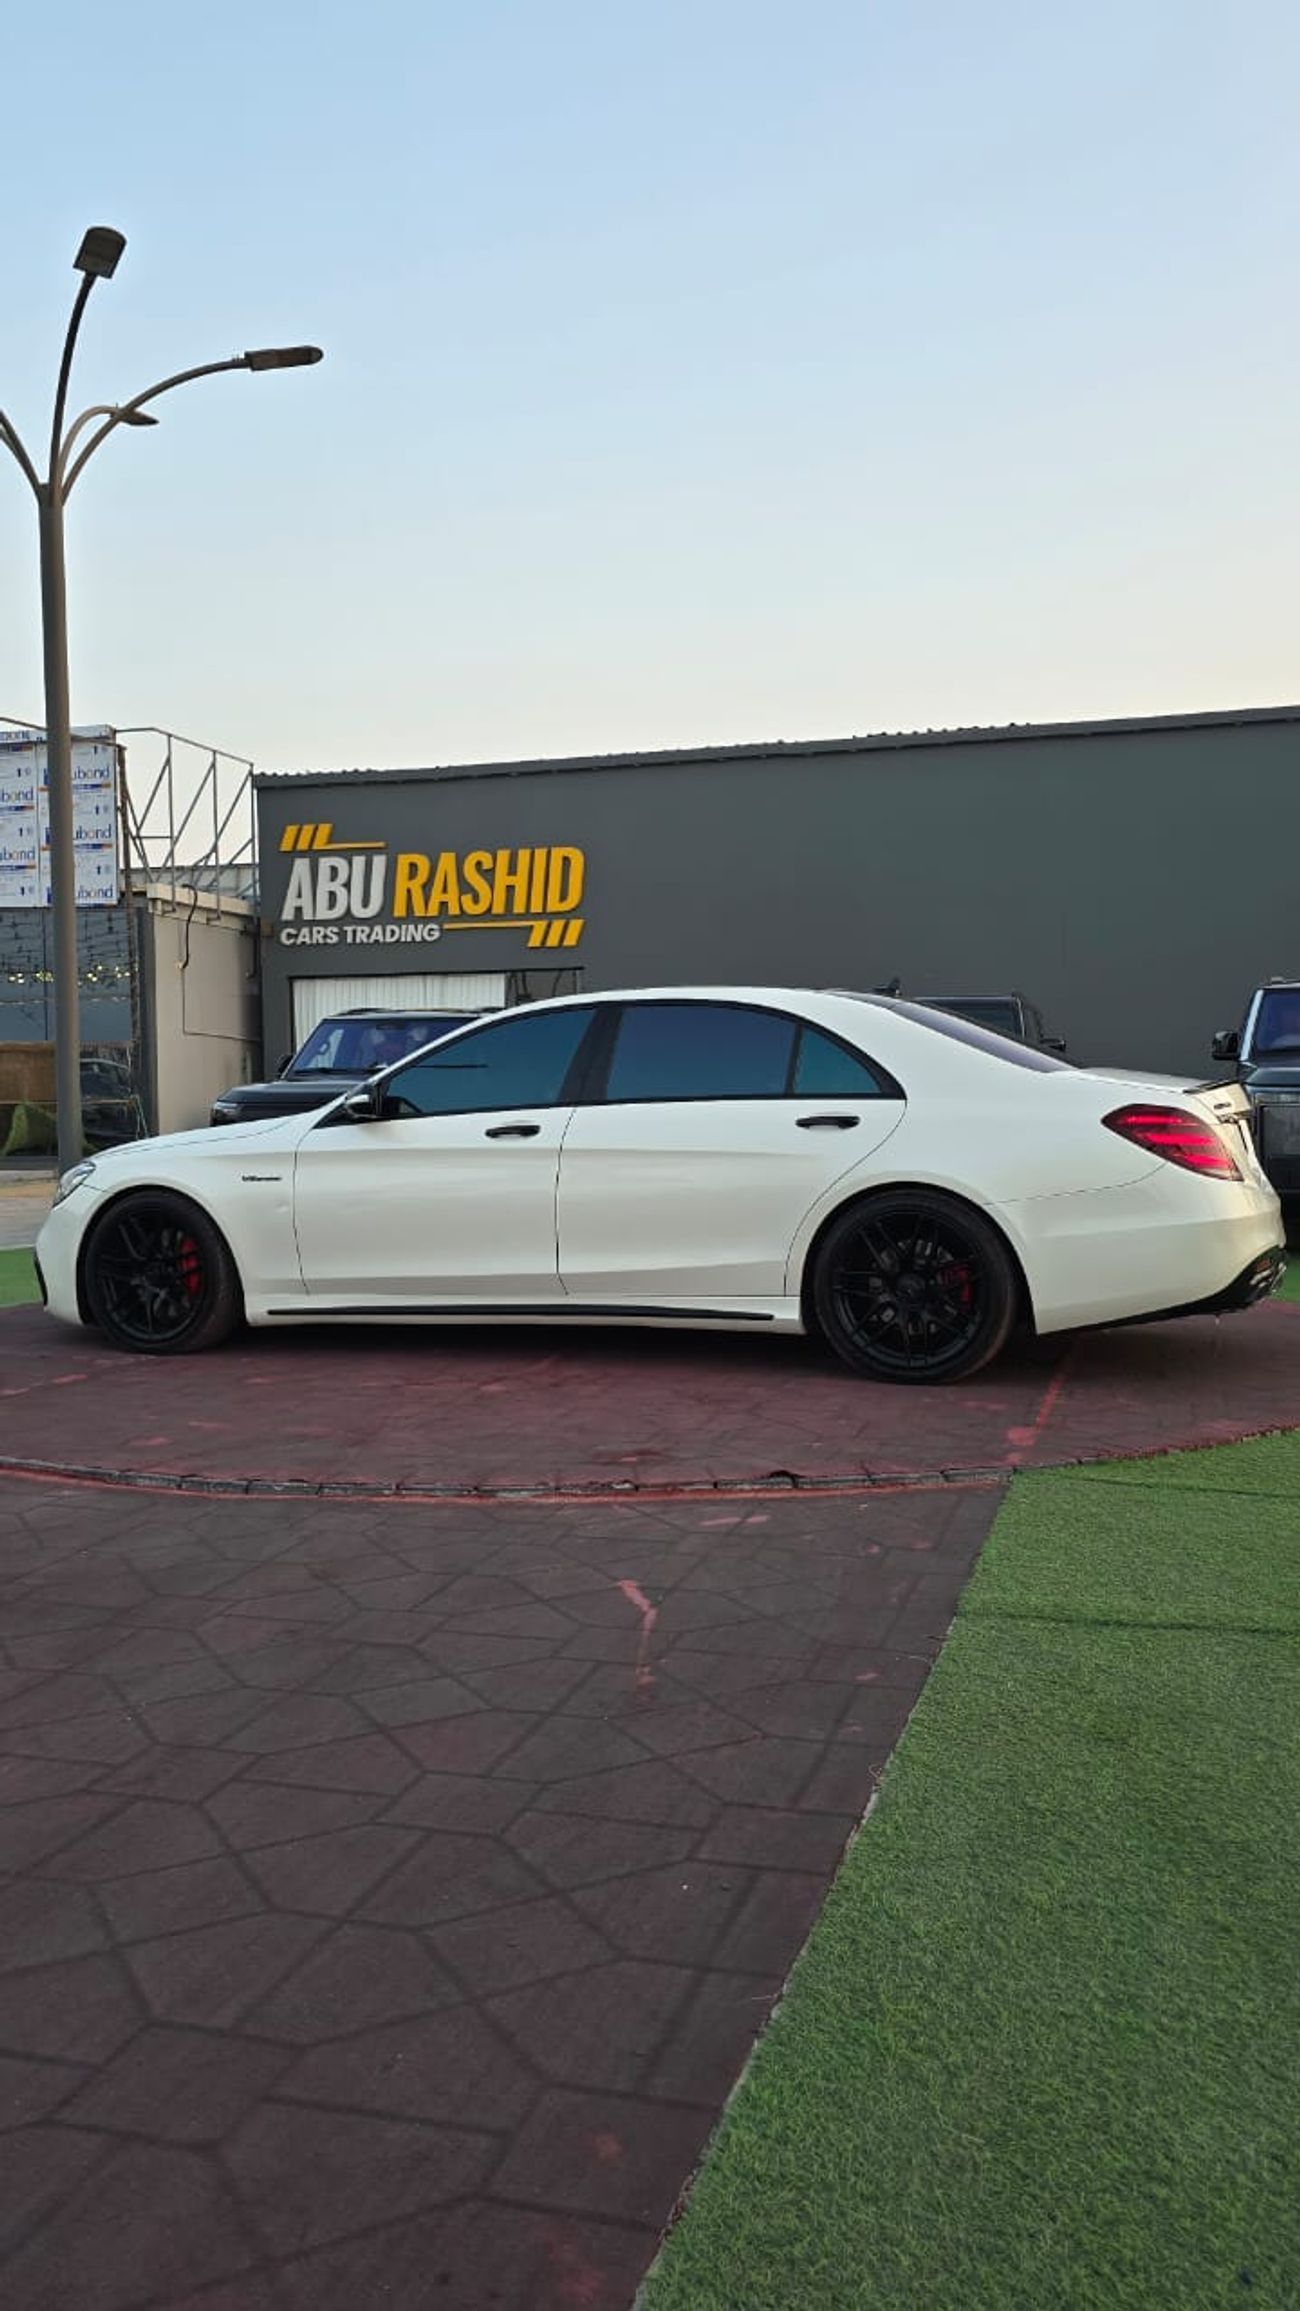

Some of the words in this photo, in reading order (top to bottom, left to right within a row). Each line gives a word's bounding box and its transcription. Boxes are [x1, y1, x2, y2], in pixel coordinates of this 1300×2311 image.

[281, 854, 386, 920] ABU
[393, 847, 585, 918] RASHID
[280, 926, 340, 946] CARS
[343, 923, 441, 944] TRADING
